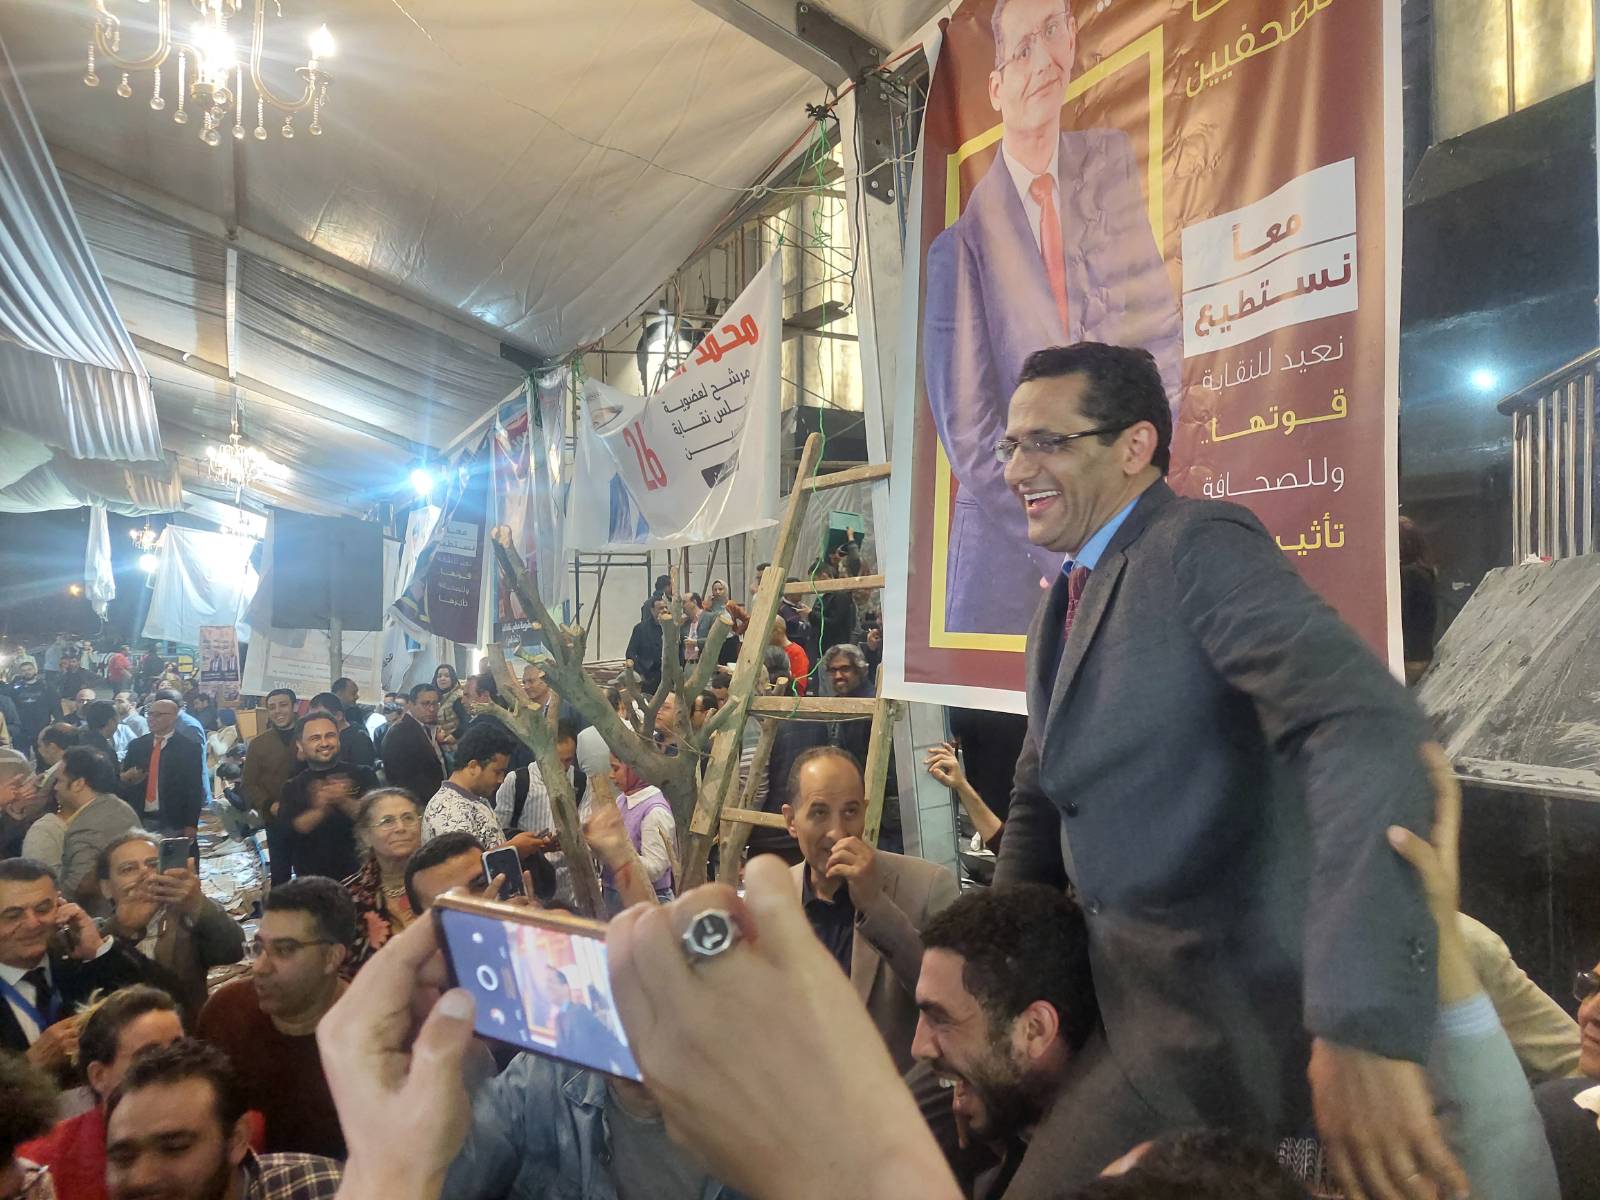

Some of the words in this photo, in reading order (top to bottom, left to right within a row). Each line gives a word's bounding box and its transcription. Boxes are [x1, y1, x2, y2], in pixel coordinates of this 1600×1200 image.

[1186, 0, 1333, 97] صحفيين
[1195, 252, 1351, 337] نستطيع
[695, 313, 759, 365] محمد
[1280, 335, 1344, 373] نعيد
[710, 367, 751, 400] مرشح
[1202, 347, 1272, 396] للنقابة
[663, 382, 708, 415] لعضوية
[673, 410, 711, 438] نقابة
[623, 420, 668, 491] 26
[1202, 456, 1345, 499] وللصحافة
